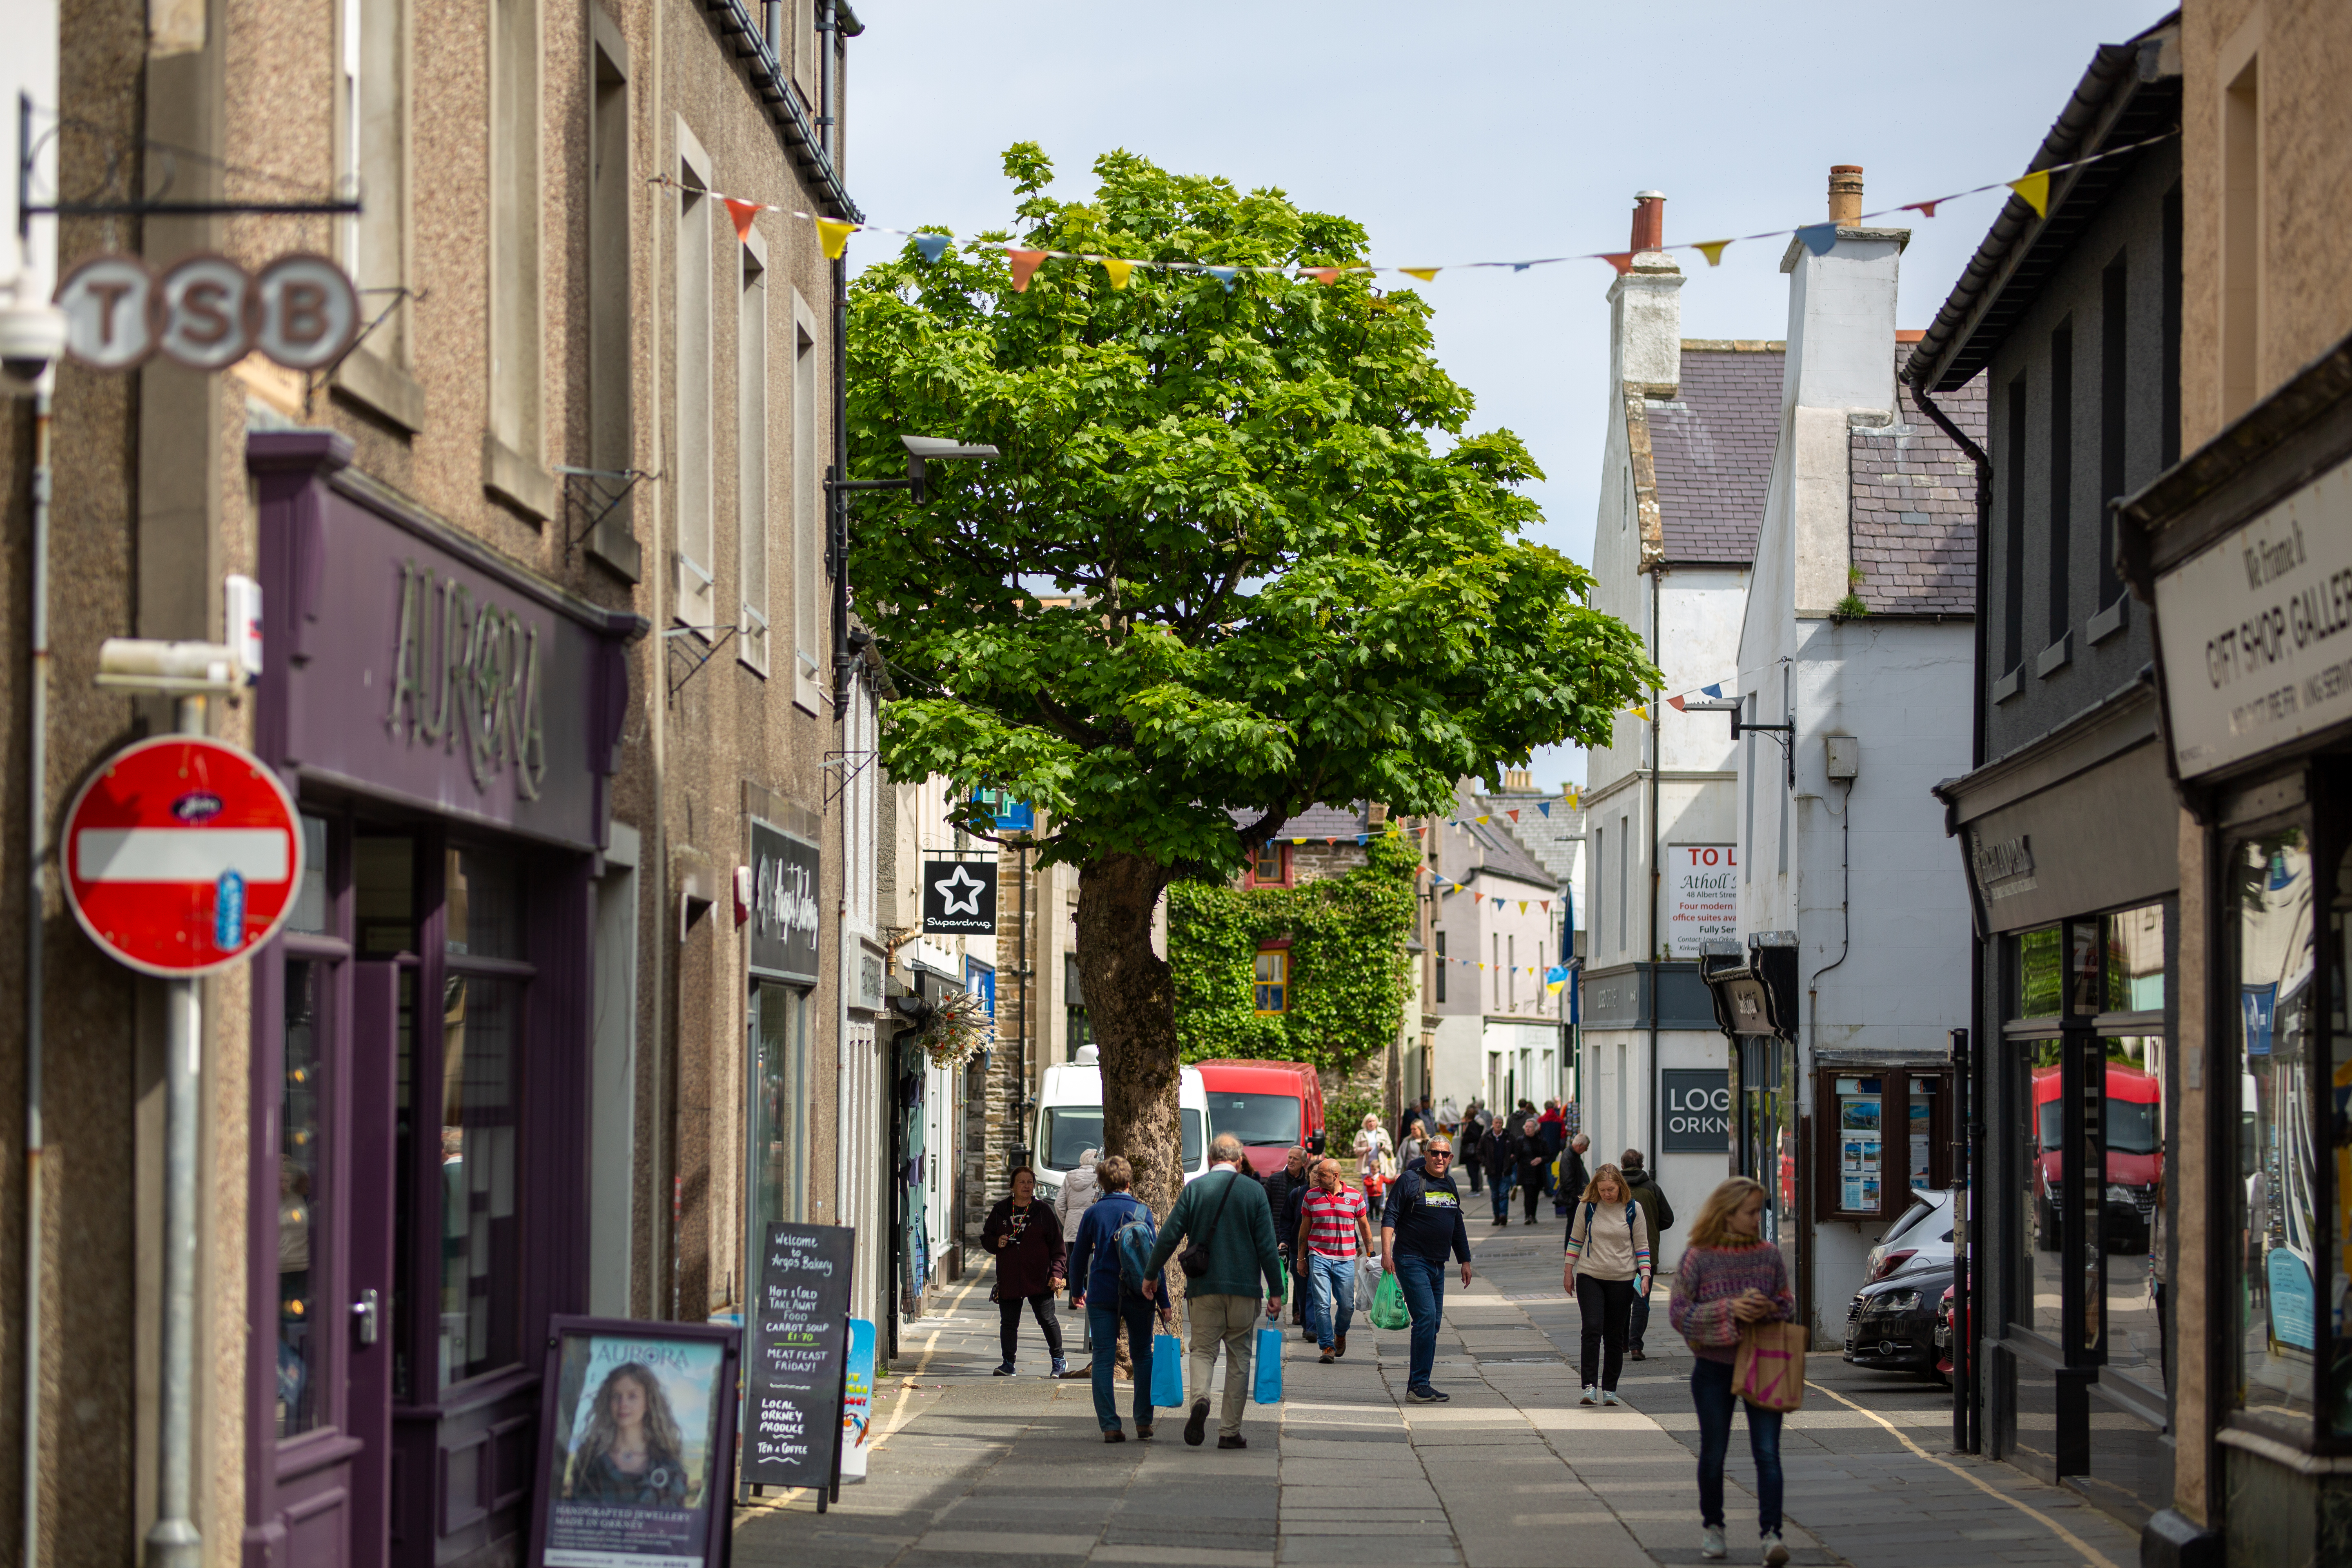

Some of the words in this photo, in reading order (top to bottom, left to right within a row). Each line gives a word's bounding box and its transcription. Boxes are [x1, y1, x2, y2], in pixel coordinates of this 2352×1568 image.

[85, 281, 331, 346] TSB
[1688, 848, 1718, 866] TO
[1680, 873, 1730, 889] Atholl
[927, 917, 992, 929] Superdrug
[1699, 925, 1719, 935] Fully
[775, 1232, 818, 1248] Welcome
[791, 1247, 802, 1258] to
[771, 1253, 800, 1272] Argos
[801, 1255, 833, 1277] Bakery
[766, 1323, 804, 1332] CARROT
[806, 1323, 829, 1332] SOUP
[596, 1343, 689, 1371] AURORA
[767, 1348, 795, 1359] MEAT
[796, 1350, 829, 1361] FEAST
[762, 1398, 796, 1410] LOCAL
[761, 1409, 802, 1422] ORKNEY
[760, 1421, 805, 1434] PRODUCE
